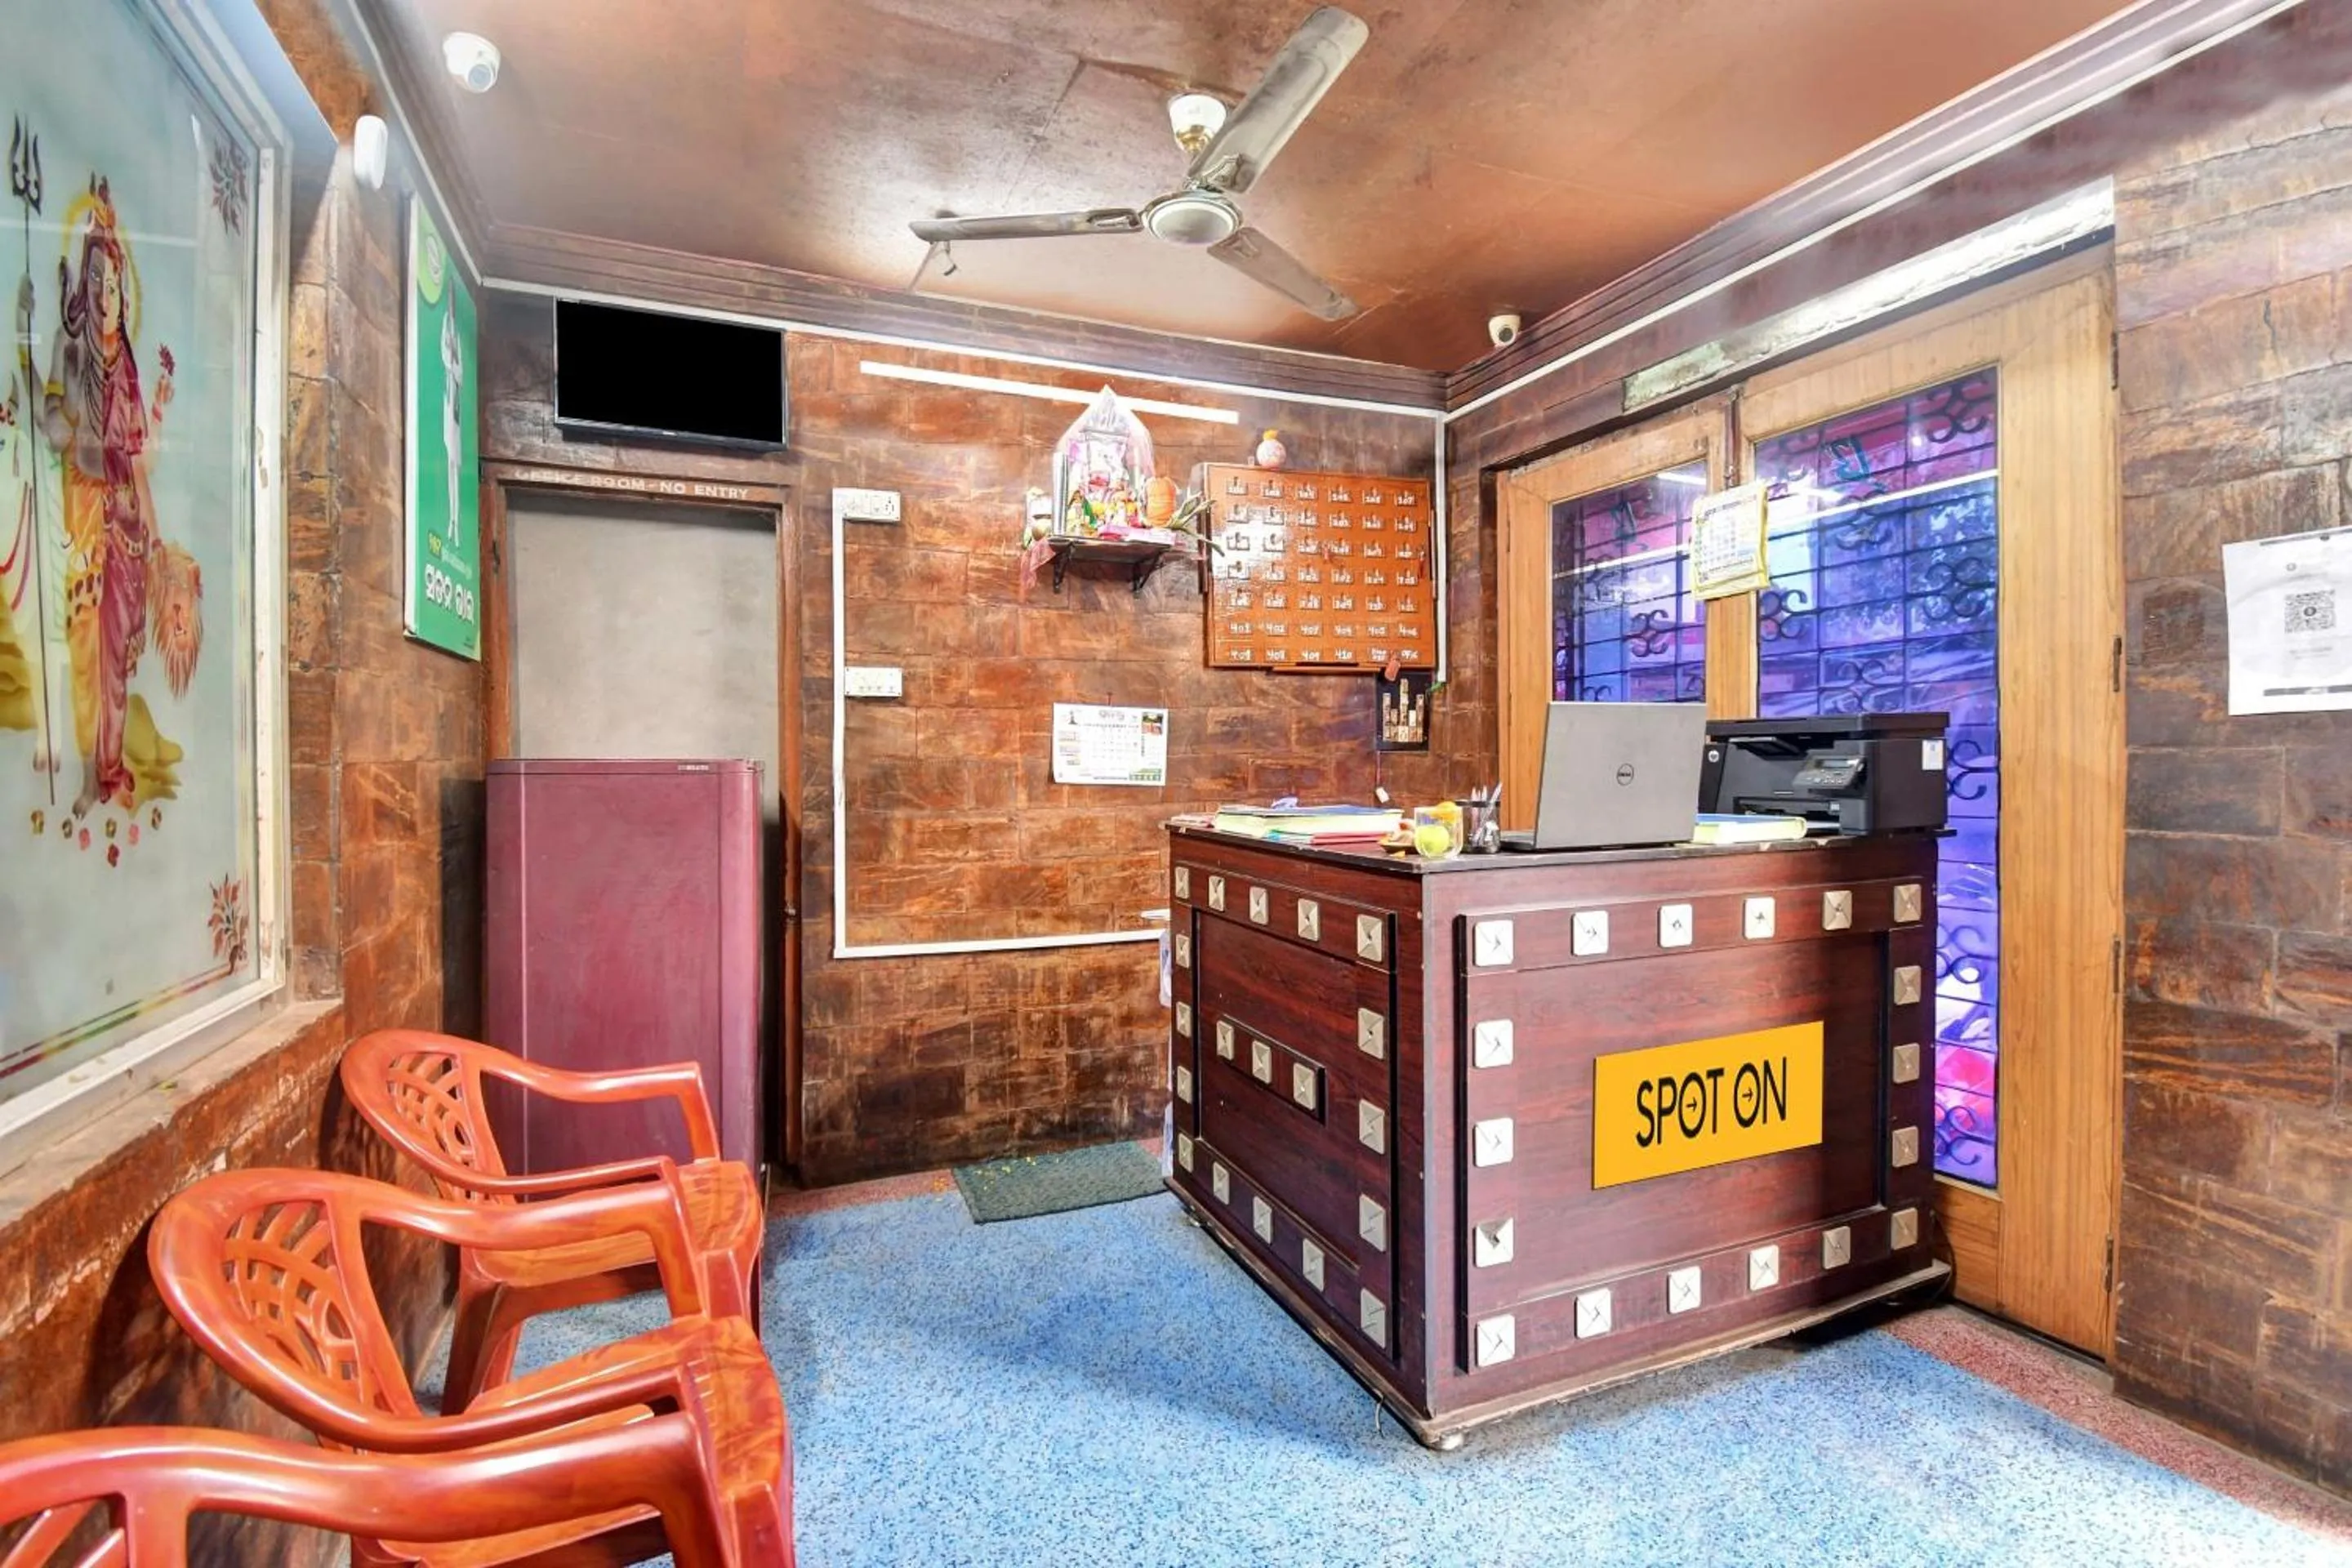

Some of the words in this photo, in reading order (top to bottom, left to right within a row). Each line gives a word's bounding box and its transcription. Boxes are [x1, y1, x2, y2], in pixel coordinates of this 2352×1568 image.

[590, 475, 645, 490] ROOM
[660, 481, 686, 494] NO
[694, 484, 749, 499] ENTRY
[1636, 1067, 1725, 1147] SPOT
[1733, 1056, 1787, 1129] ON
